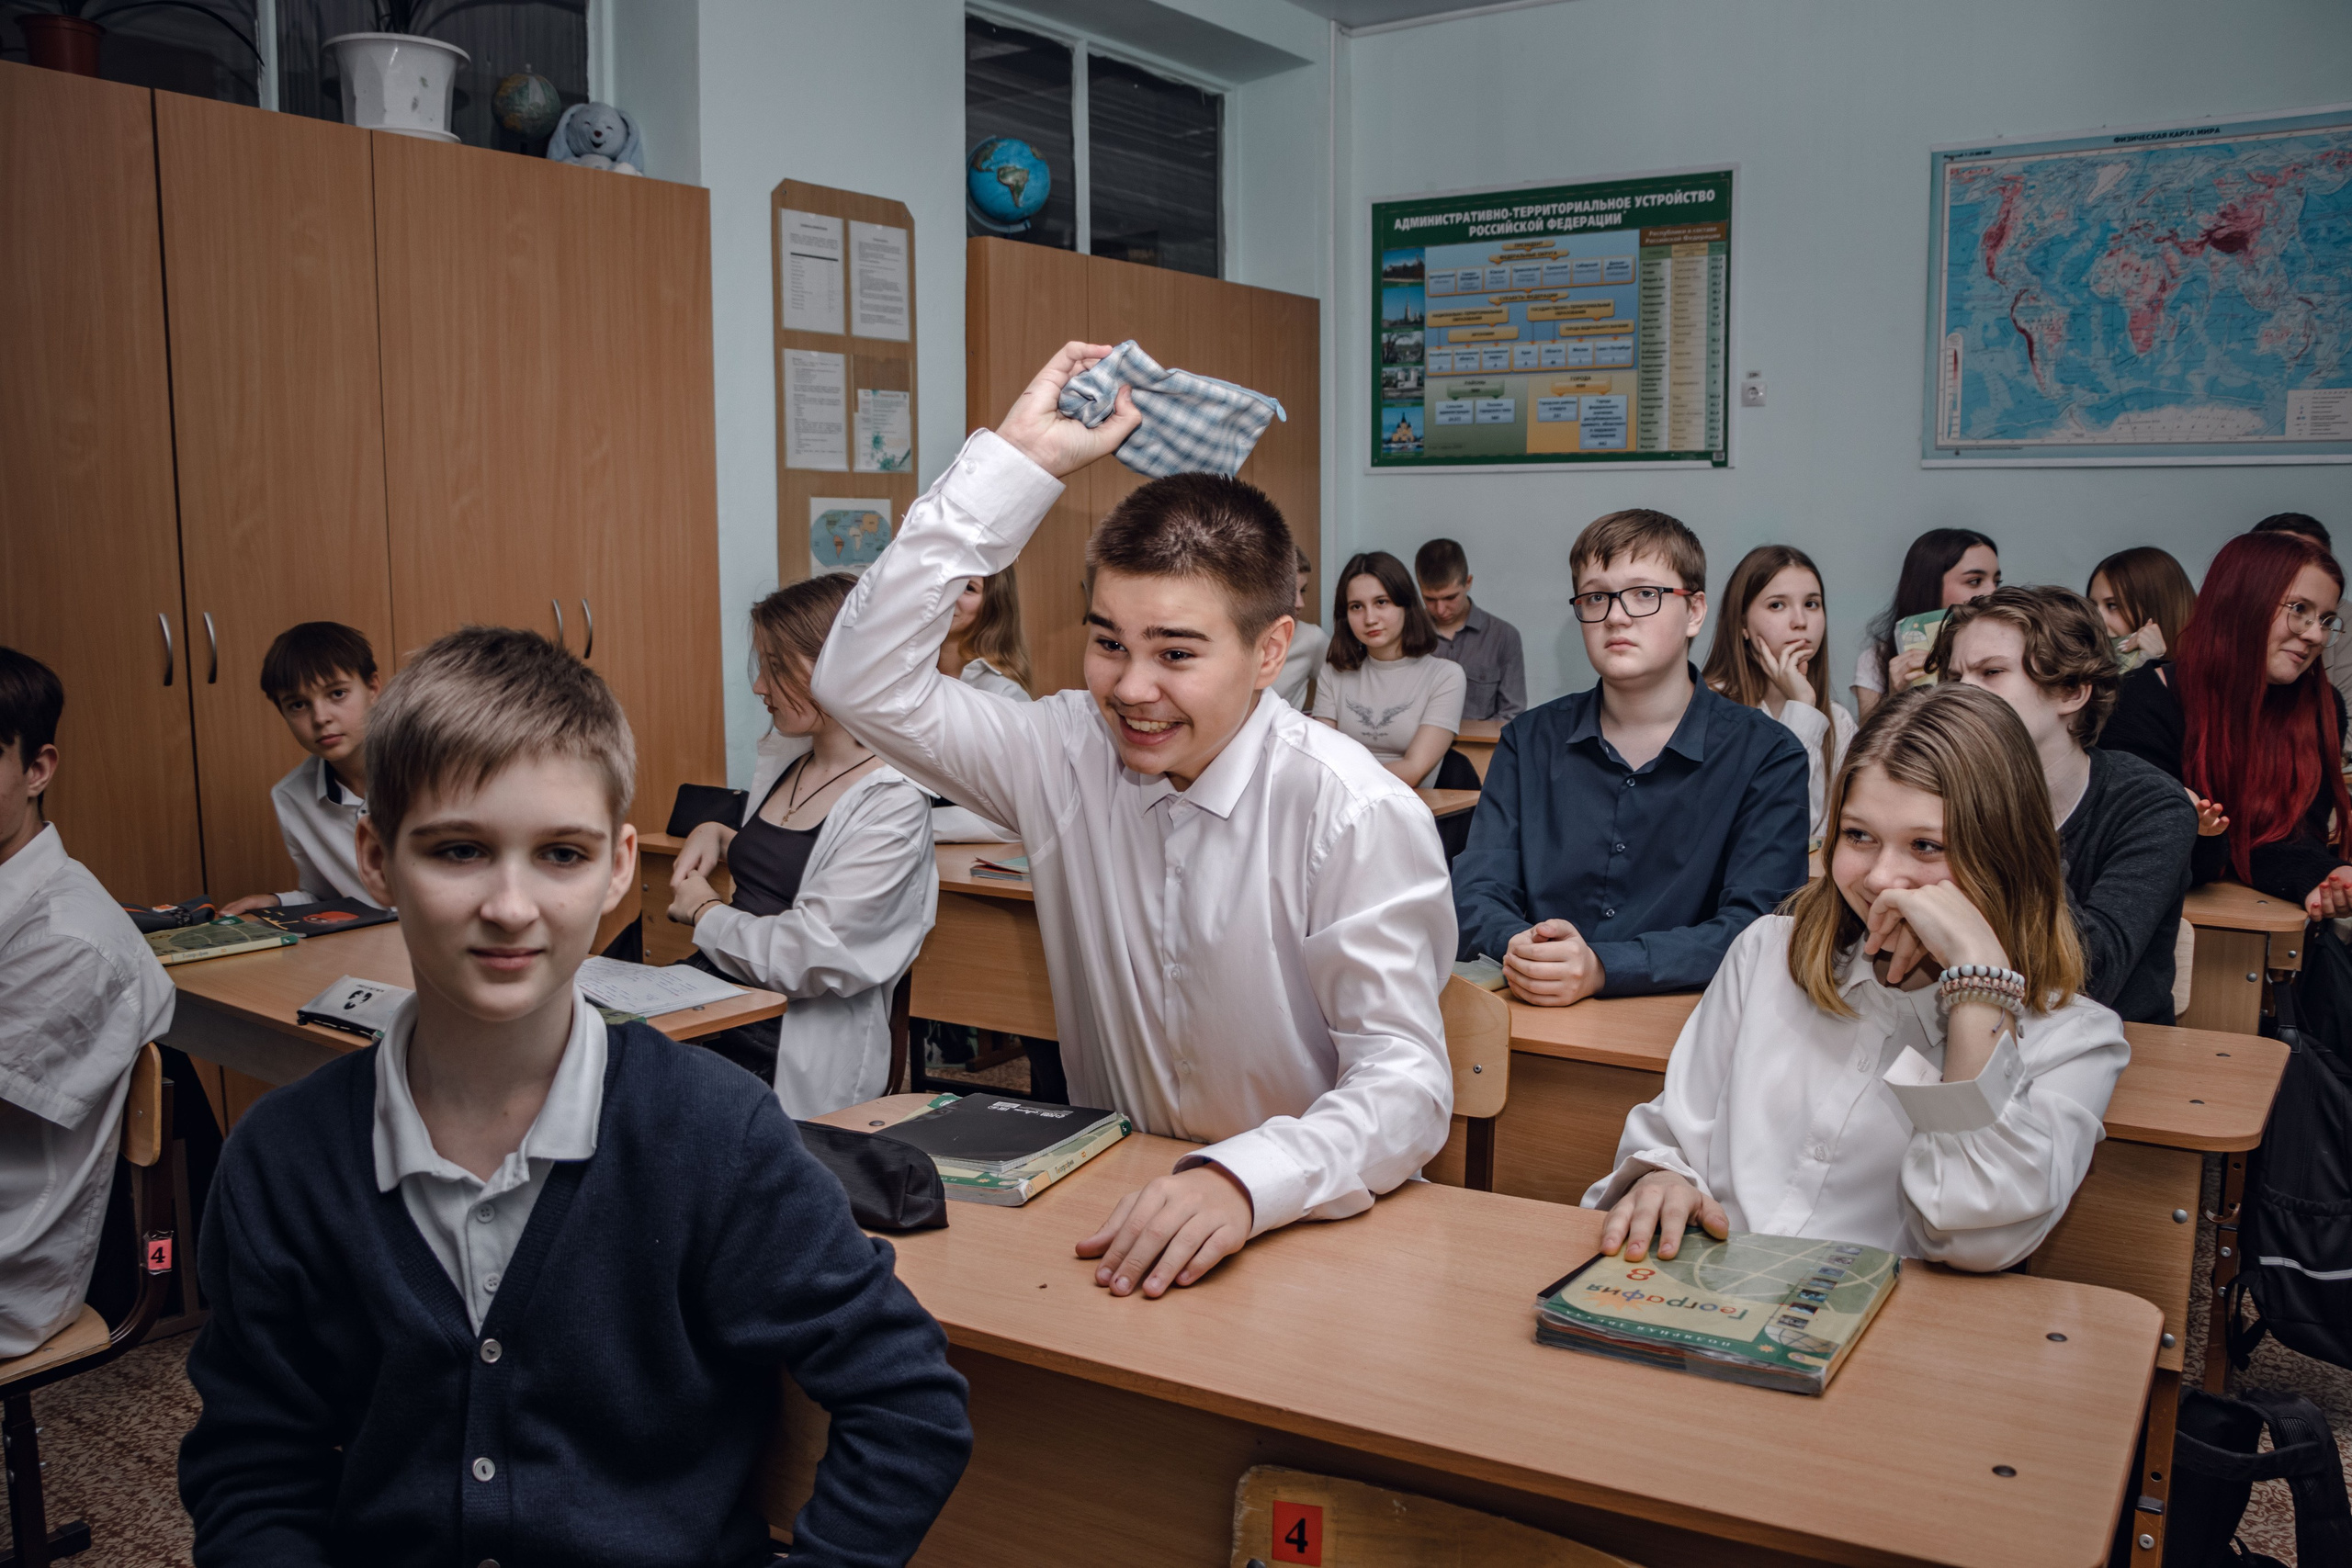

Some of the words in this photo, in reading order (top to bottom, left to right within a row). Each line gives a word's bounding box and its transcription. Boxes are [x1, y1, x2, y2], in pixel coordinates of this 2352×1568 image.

[2113, 132, 2167, 143] ФИЗИЧЕСКАЯ
[2169, 130, 2195, 139] КАРТА
[2197, 127, 2221, 136] МИРА
[1394, 196, 1631, 231] АДМИНИСТРАТИВНО-ТЕРРИТОРИАЛЬНОЕ
[1634, 188, 1715, 209] УСТРОЙСТВО
[1469, 216, 1544, 237] РОССИЙСКОЙ
[1546, 212, 1623, 232] ФЕДЕРАЦИИ
[150, 1247, 166, 1264] 4
[1625, 1268, 1656, 1280] 8
[1586, 1283, 1748, 1320] География
[1284, 1517, 1308, 1554] 4
